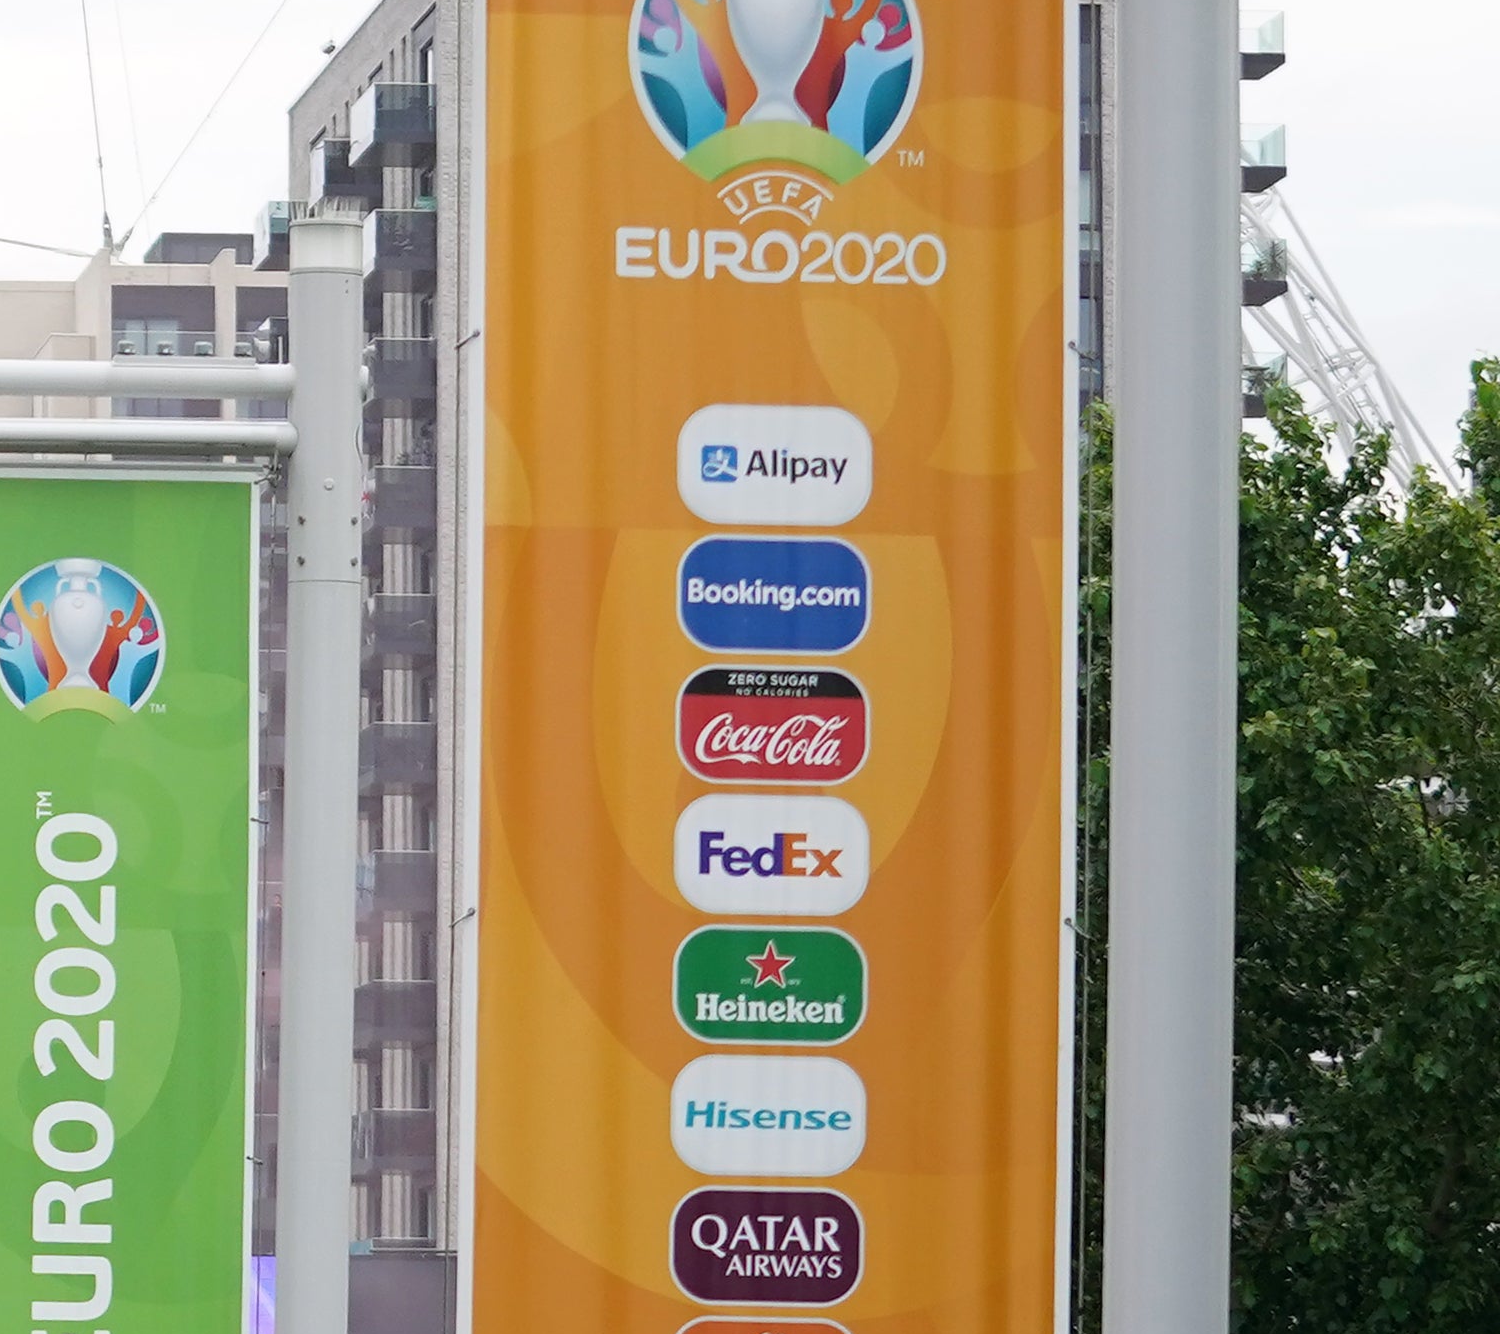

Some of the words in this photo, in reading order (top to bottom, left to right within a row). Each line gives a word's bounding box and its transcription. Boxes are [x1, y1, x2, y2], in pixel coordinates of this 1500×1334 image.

[723, 178, 825, 220] UEFA
[615, 226, 947, 285] EURO2020
[744, 448, 848, 485] Alipay
[687, 578, 860, 611] Booking.com
[727, 674, 766, 687] ZERO
[770, 675, 818, 689] SUGAR
[695, 714, 849, 767] Coca-Cola
[699, 831, 843, 878] FedEx
[695, 993, 844, 1024] Heineken
[685, 1100, 852, 1131] Hisense
[691, 1215, 840, 1259] QATAR
[725, 1254, 842, 1279] AIRWAYS
